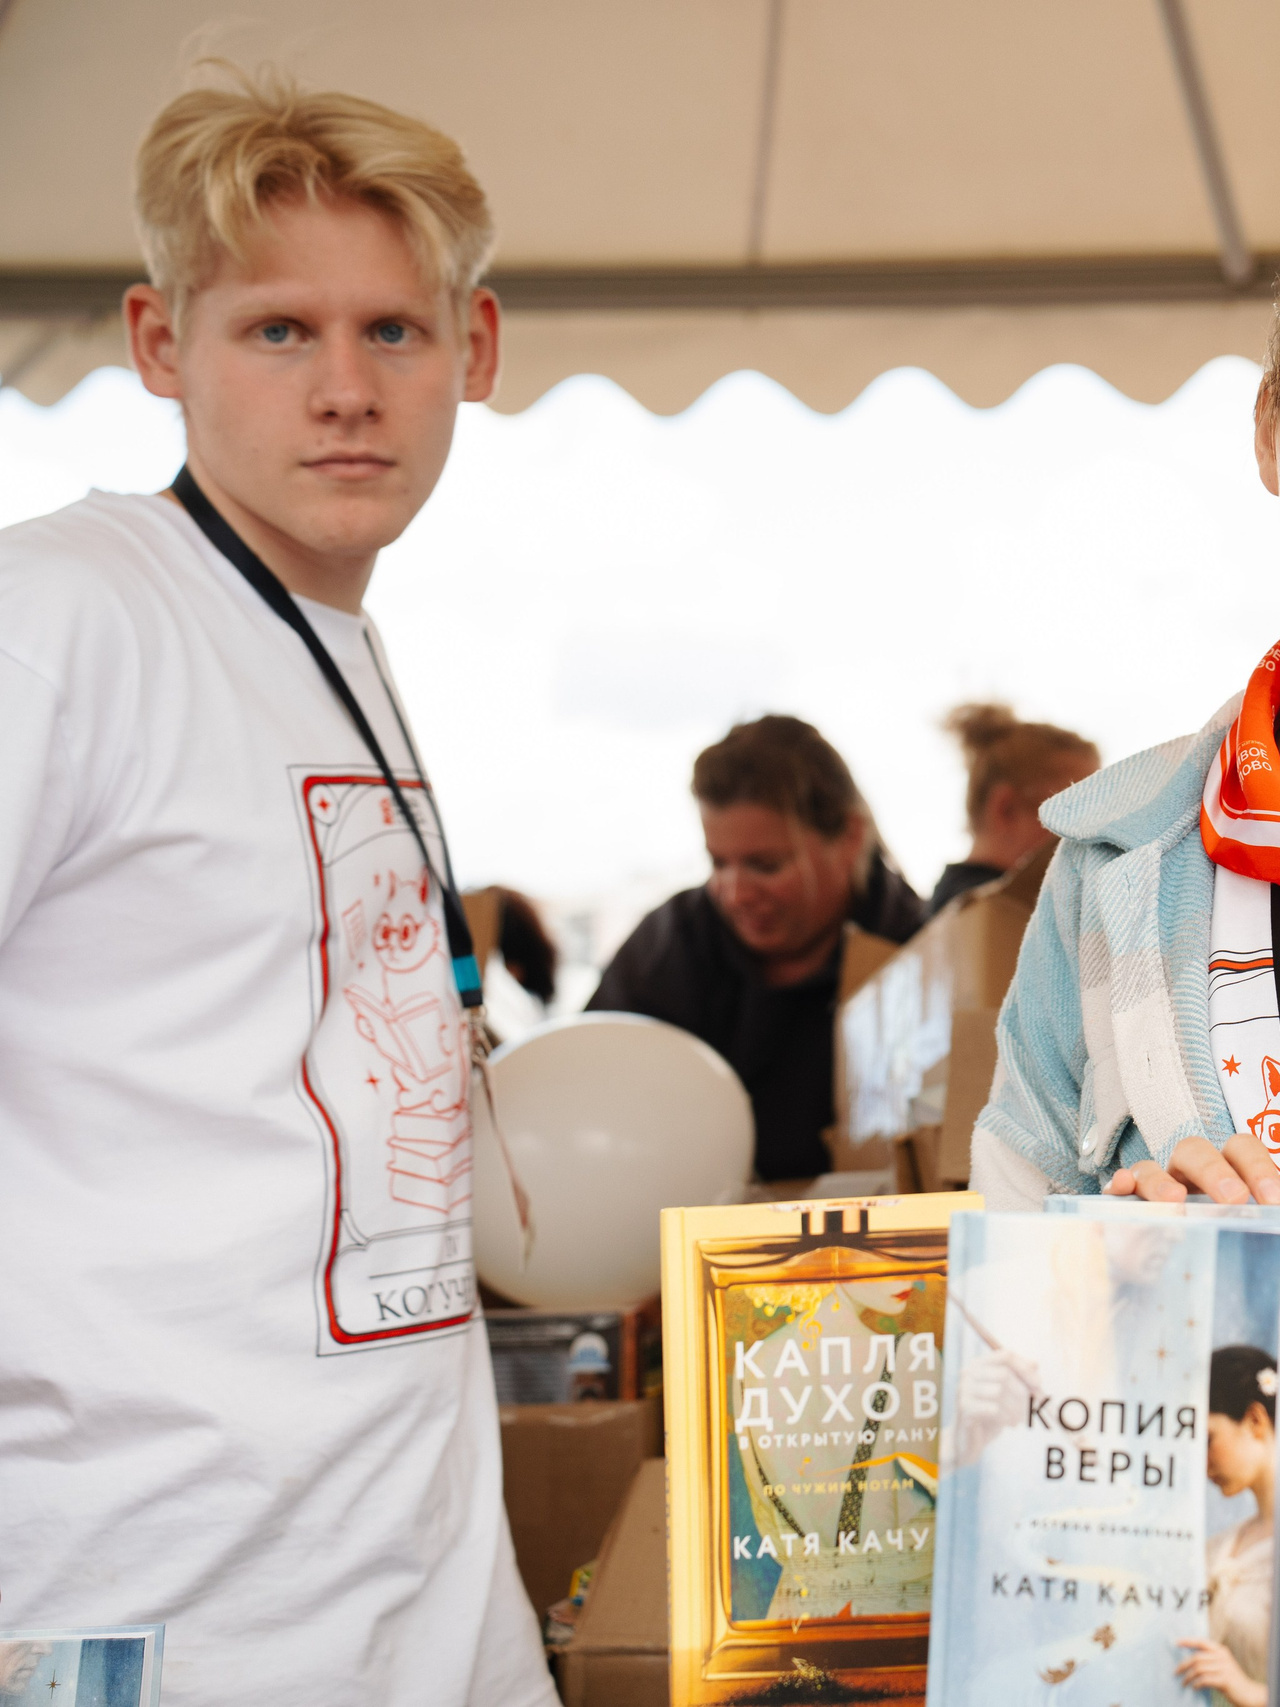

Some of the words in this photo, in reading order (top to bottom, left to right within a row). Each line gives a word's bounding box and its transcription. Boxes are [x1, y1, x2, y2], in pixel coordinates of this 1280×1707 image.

[1237, 747, 1269, 765] ВОЕ
[734, 1332, 936, 1380] КАПЛЯ
[734, 1380, 938, 1434] ДУХОВ
[1027, 1396, 1196, 1439] КОПИЯ
[739, 1436, 749, 1450] В
[757, 1429, 876, 1450] ОТКРЫТУЮ
[884, 1426, 938, 1443] РАНУ
[1045, 1447, 1175, 1488] ВЕРЫ
[763, 1484, 786, 1497] ПО
[791, 1481, 852, 1495] ЧУЖИМ
[858, 1478, 914, 1492] НОТАМ
[733, 1532, 821, 1560] КАТЯ
[837, 1527, 930, 1556] КАЧУ
[992, 1572, 1077, 1602] КАТЯ
[1097, 1583, 1213, 1611] КАЧУР
